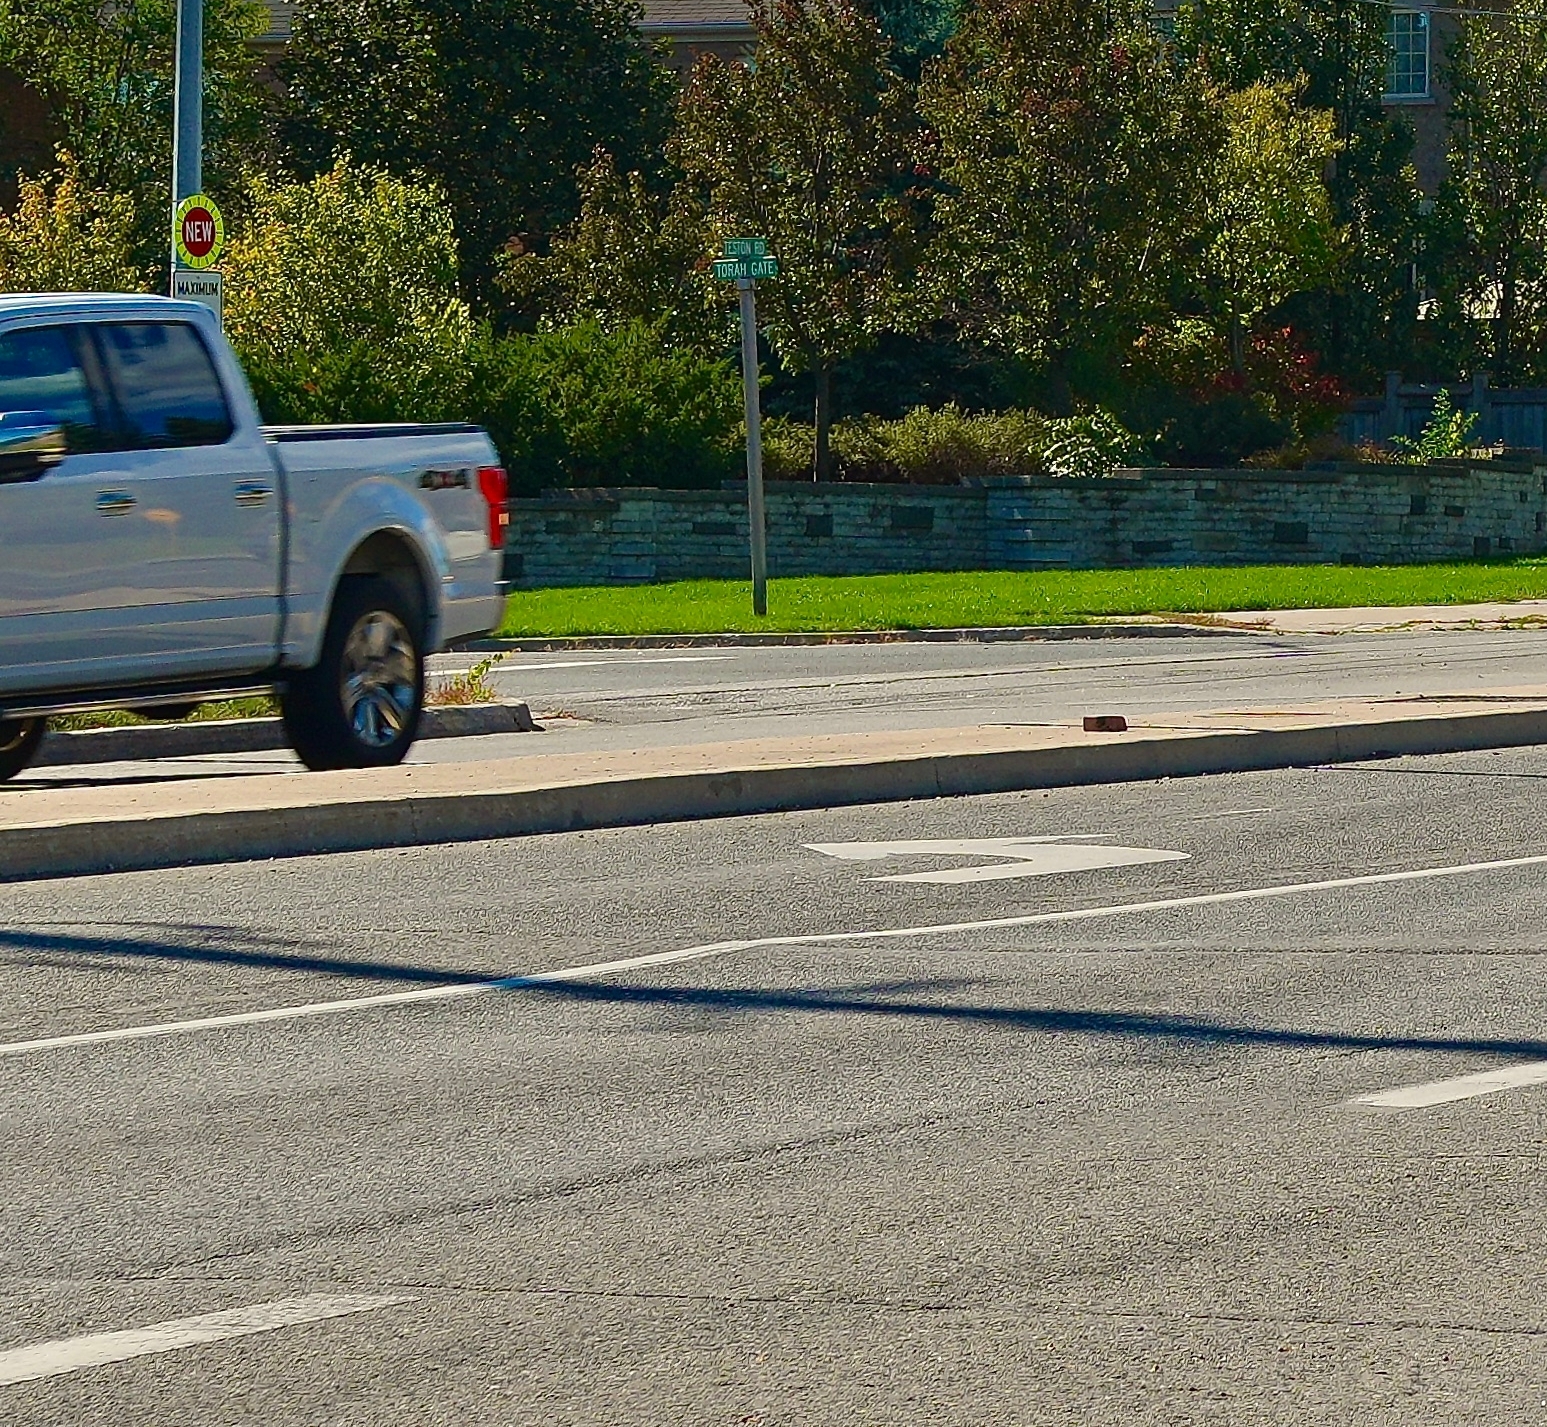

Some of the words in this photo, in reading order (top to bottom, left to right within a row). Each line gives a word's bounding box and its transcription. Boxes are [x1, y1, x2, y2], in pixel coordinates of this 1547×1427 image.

[185, 221, 213, 242] NEW
[716, 262, 747, 278] TORAH
[751, 261, 774, 276] GATE
[177, 281, 219, 296] MAXIMUM
